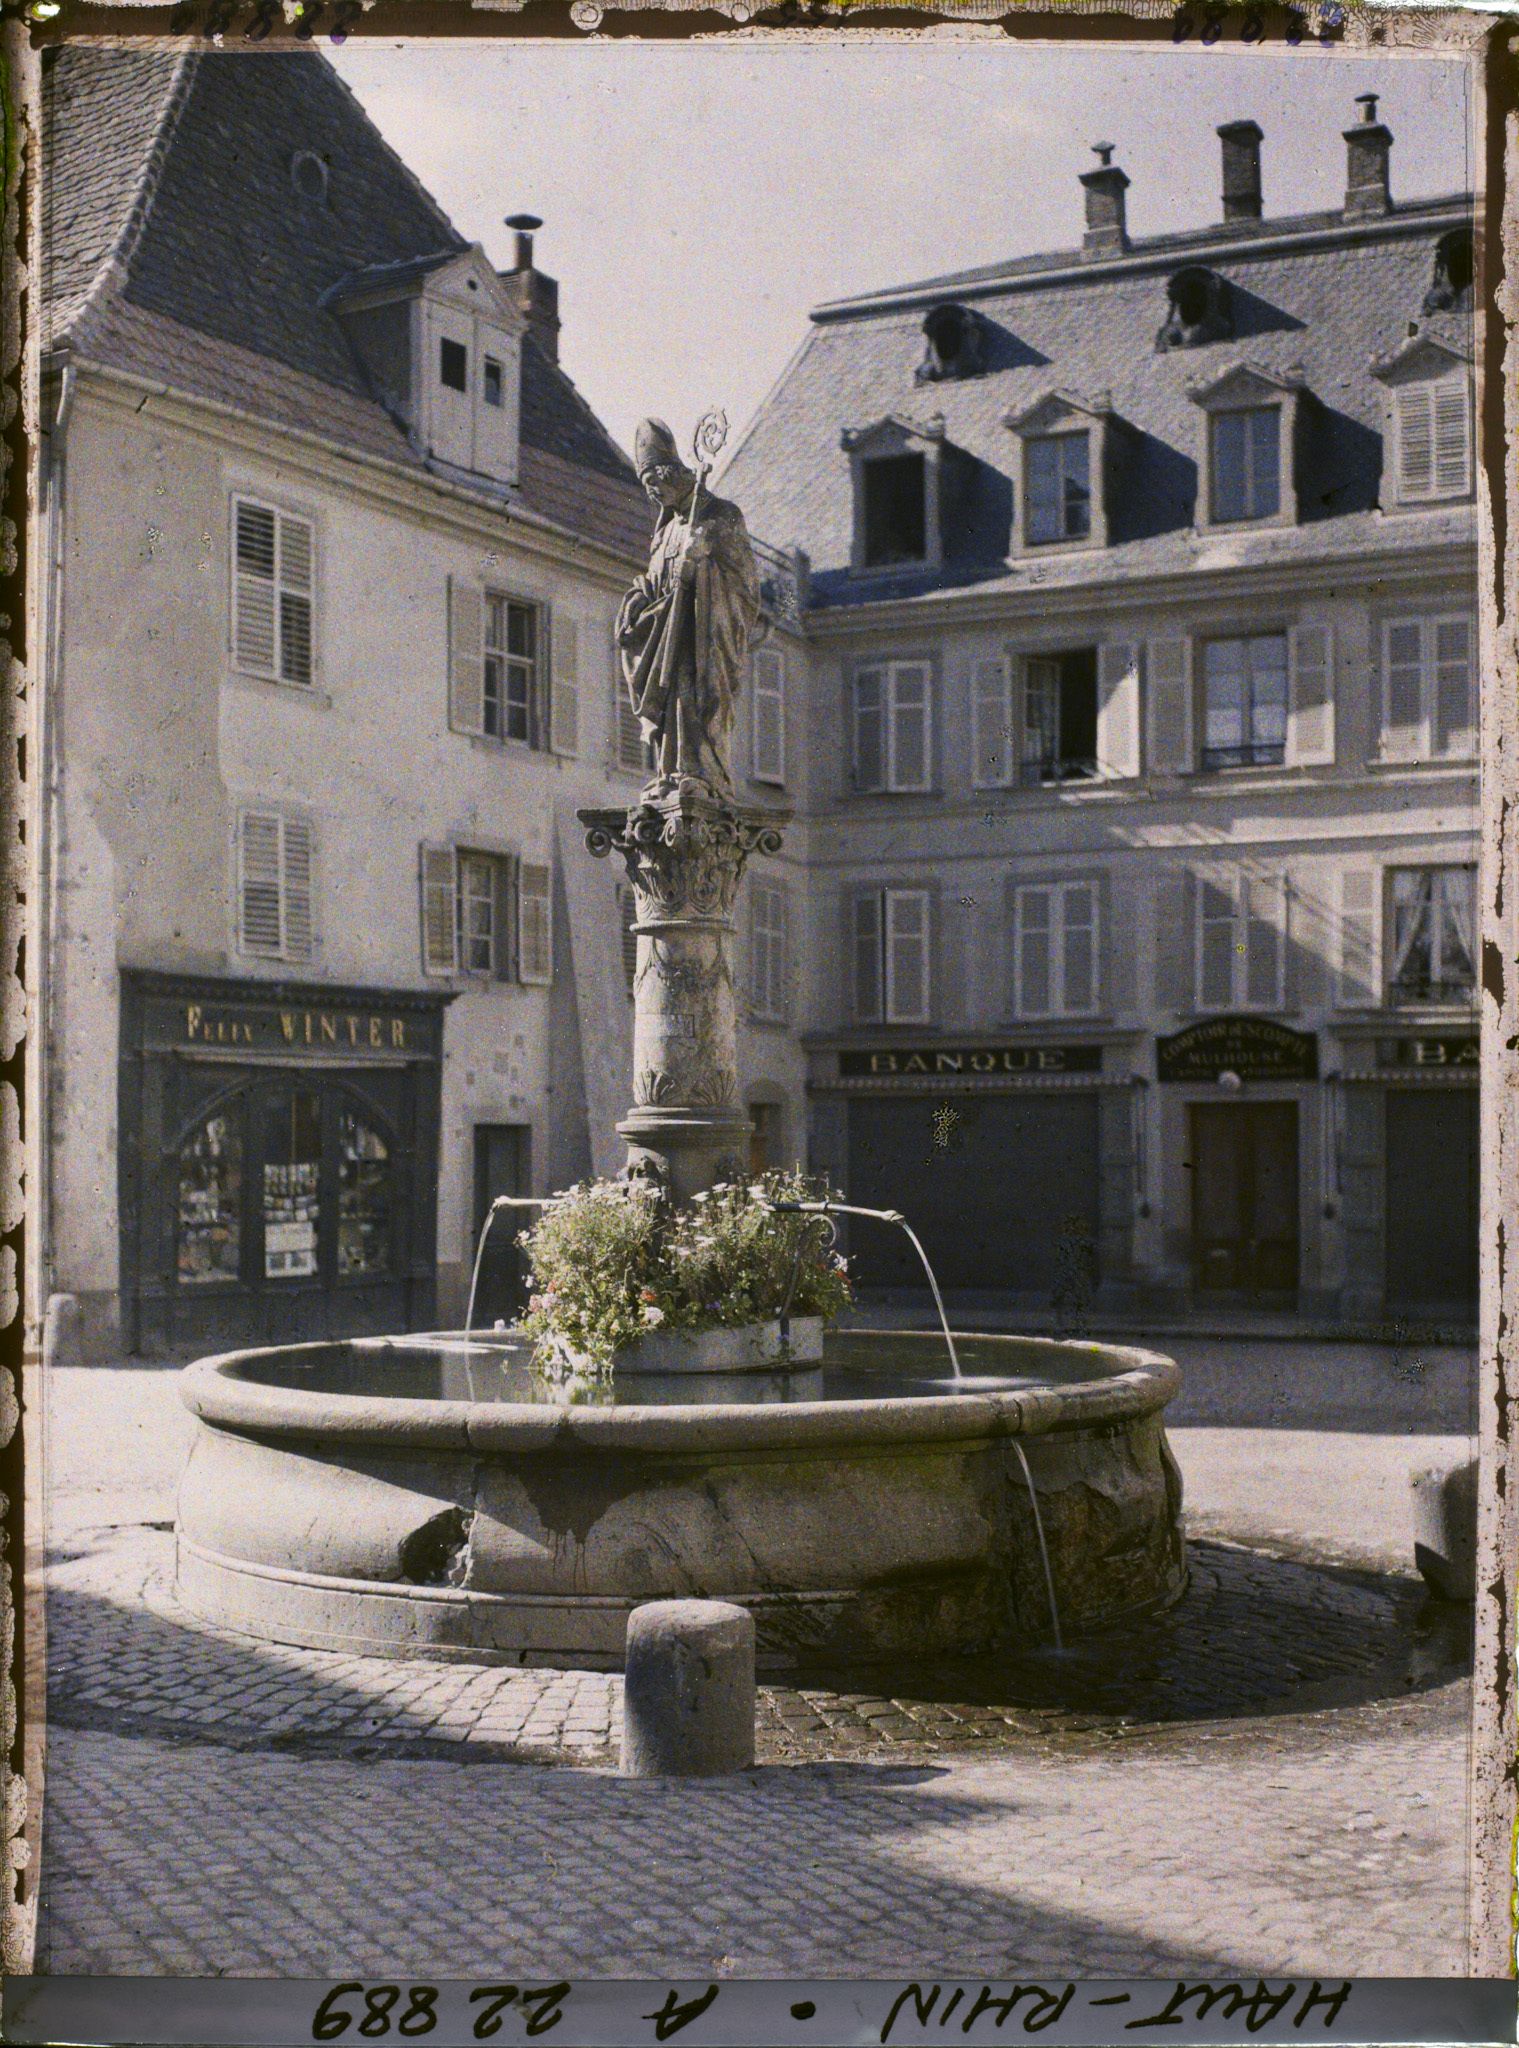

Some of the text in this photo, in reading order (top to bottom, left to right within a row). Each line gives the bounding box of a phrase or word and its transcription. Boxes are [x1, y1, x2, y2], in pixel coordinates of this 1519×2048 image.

[280, 1012, 405, 1048] WINTER
[870, 1049, 1066, 1073] BANQUE
[1187, 1050, 1284, 1066] MULHOUSE
[643, 1984, 719, 2041] A
